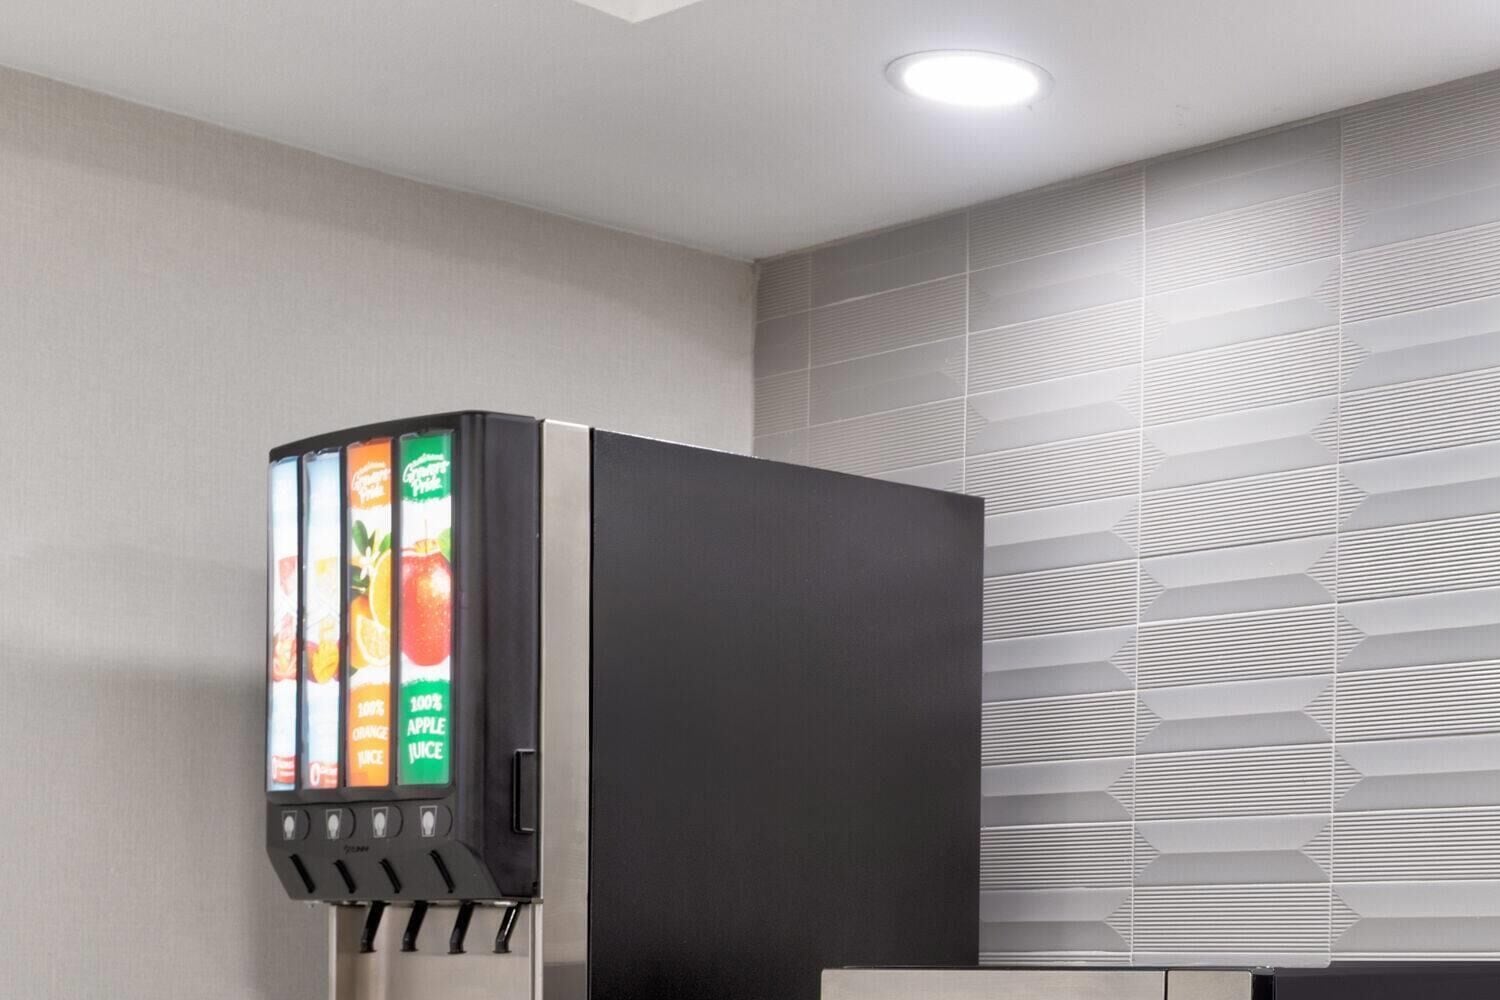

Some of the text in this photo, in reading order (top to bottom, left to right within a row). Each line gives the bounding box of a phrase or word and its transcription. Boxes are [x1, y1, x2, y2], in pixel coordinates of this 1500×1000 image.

[410, 692, 443, 713] 100%
[407, 716, 446, 736] APPLE
[357, 749, 384, 768] JUICE
[408, 741, 444, 764] JUICE
